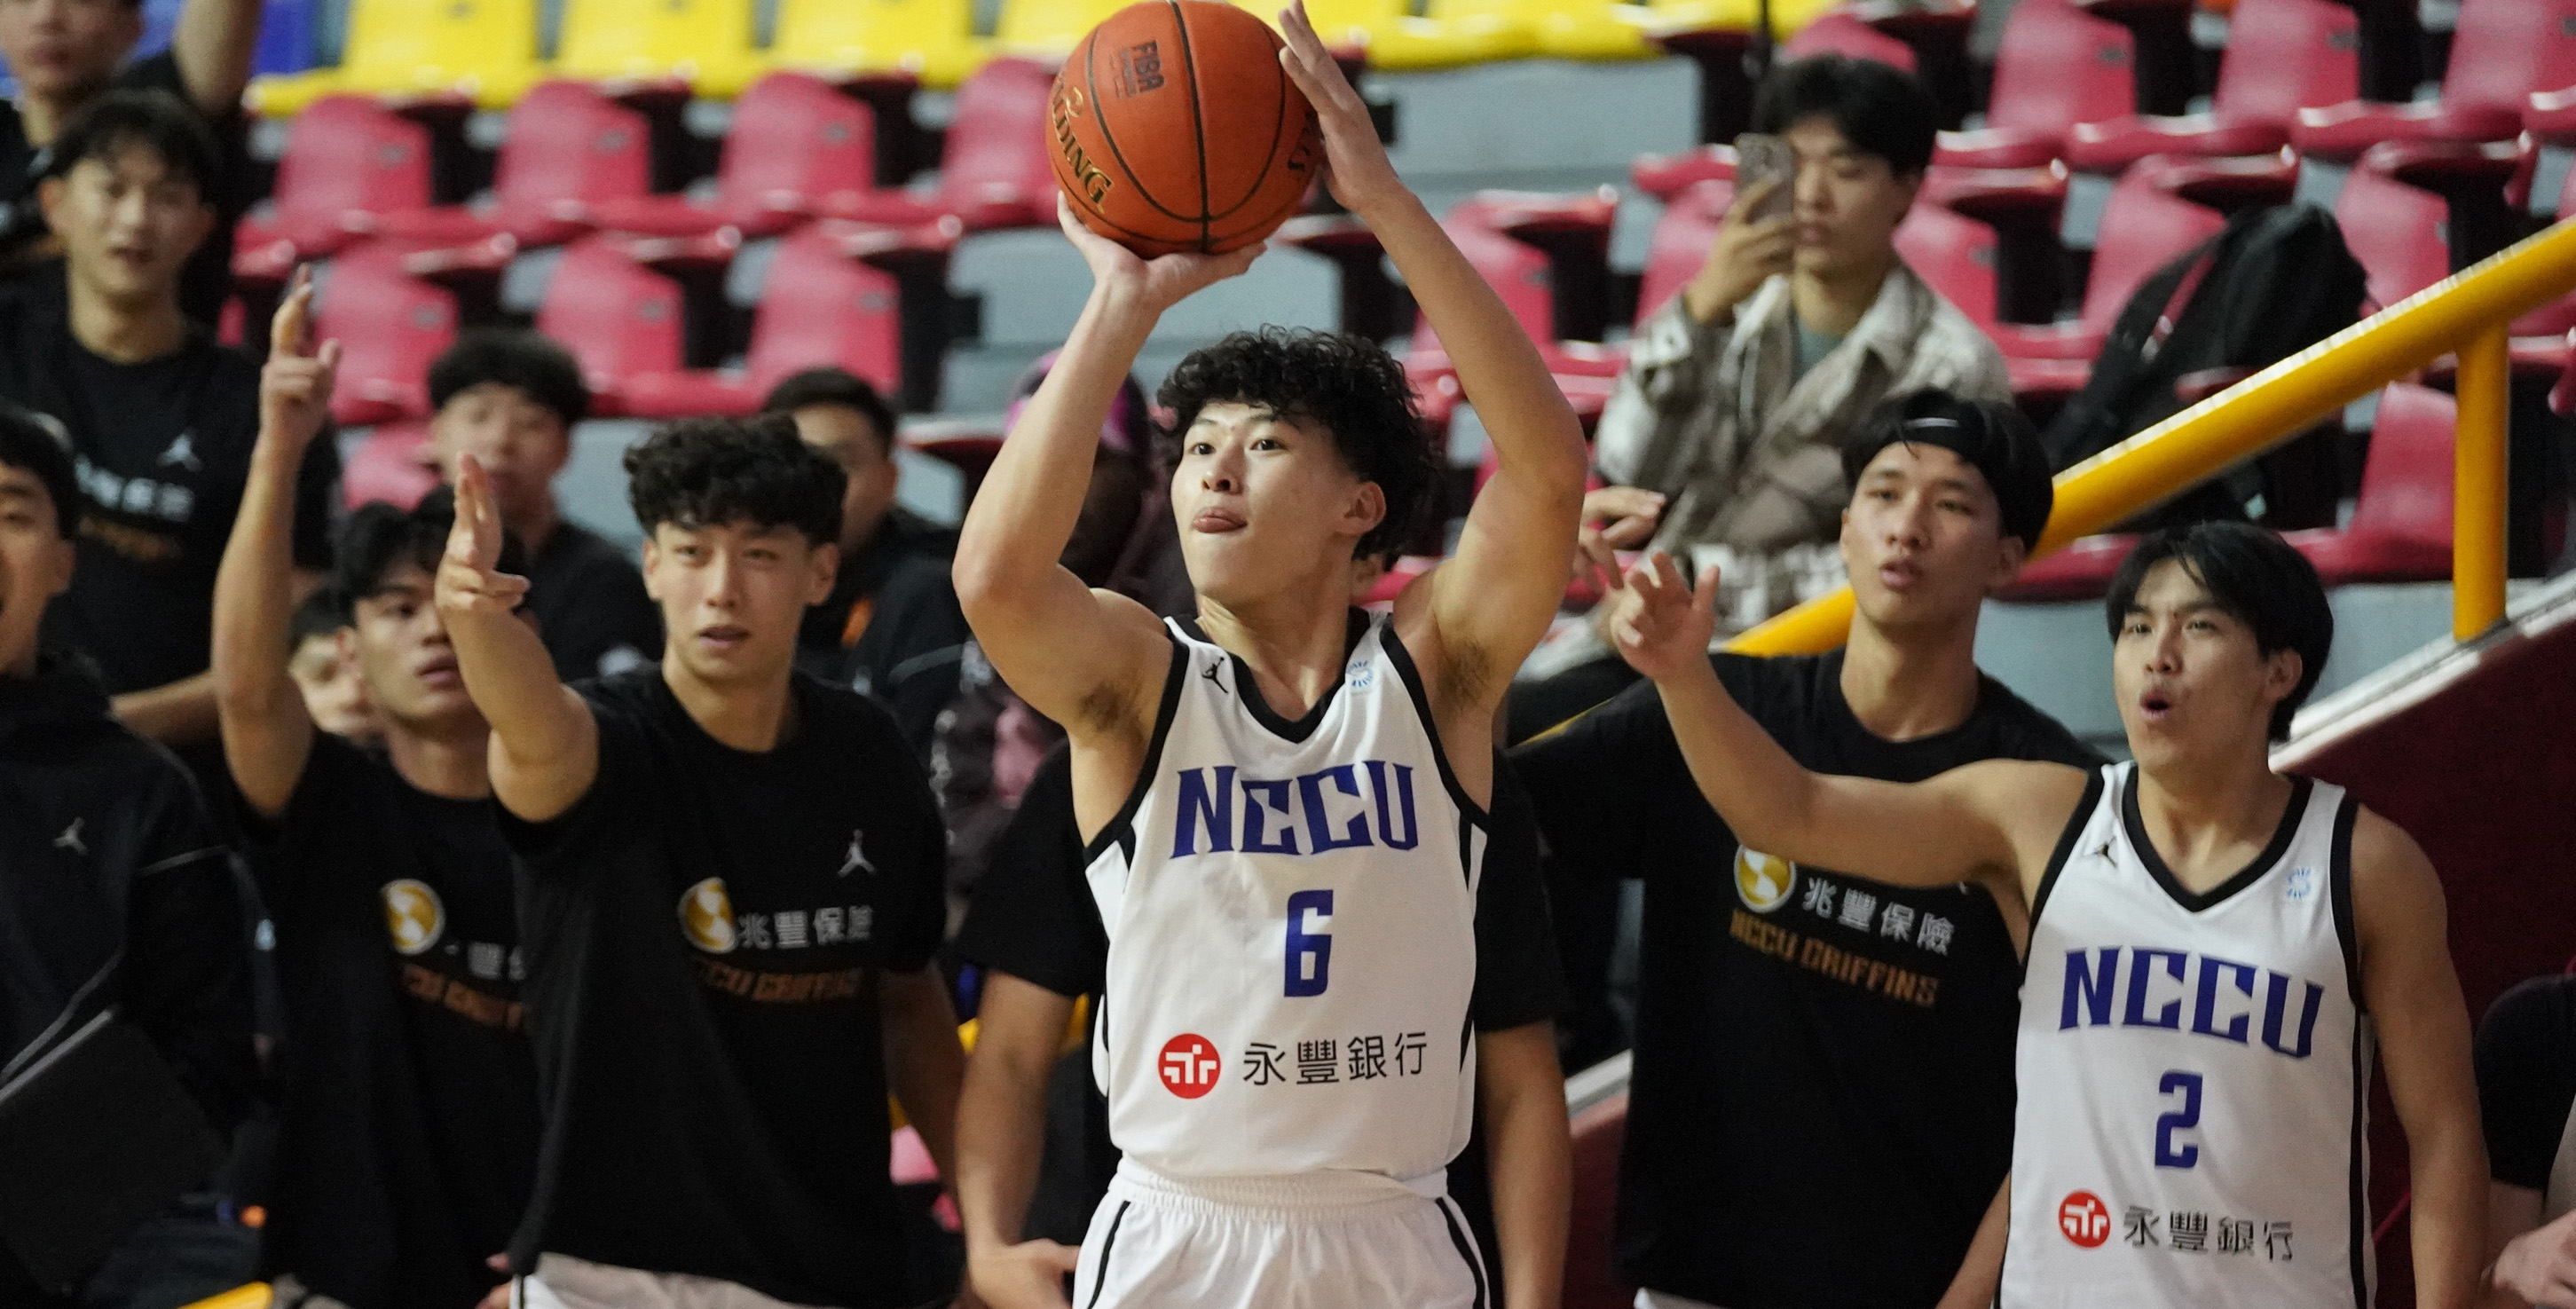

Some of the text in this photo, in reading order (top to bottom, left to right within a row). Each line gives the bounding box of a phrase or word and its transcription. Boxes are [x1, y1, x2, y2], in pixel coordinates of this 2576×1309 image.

[1133, 39, 1164, 92] FIBA
[1170, 761, 1419, 858] NCCU
[1284, 889, 1334, 998] 6
[1730, 909, 1938, 1006] NCCU GRIFFINS
[1802, 878, 1954, 955] 兆豐保險
[2059, 945, 2325, 1059] NCCU
[1243, 1032, 1428, 1085] 永豐銀行
[2154, 1068, 2204, 1169] 2
[2123, 1205, 2294, 1261] 永豐銀行
